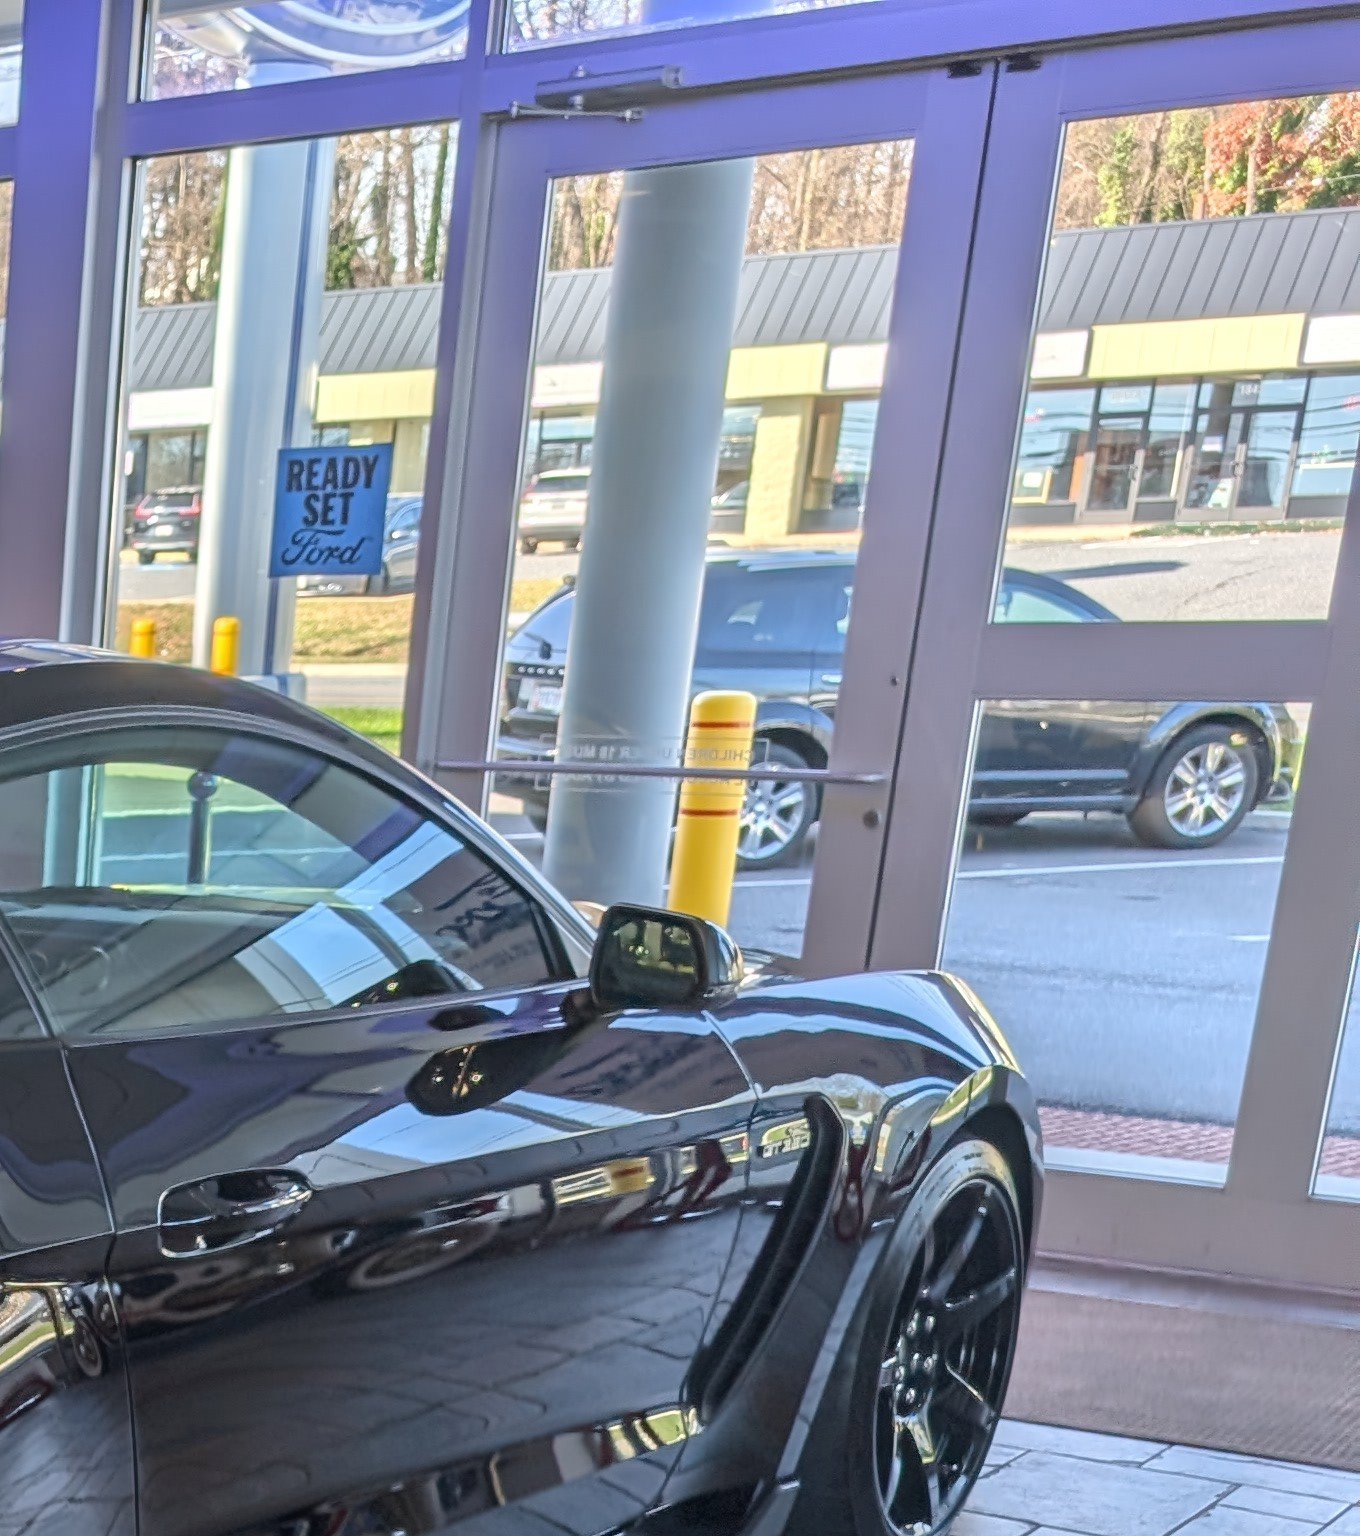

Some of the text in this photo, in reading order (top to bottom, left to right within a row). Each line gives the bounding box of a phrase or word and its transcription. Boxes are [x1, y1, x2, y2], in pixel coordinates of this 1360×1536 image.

[285, 454, 379, 493] READY
[302, 491, 354, 527] SET
[281, 528, 372, 566] Ford
